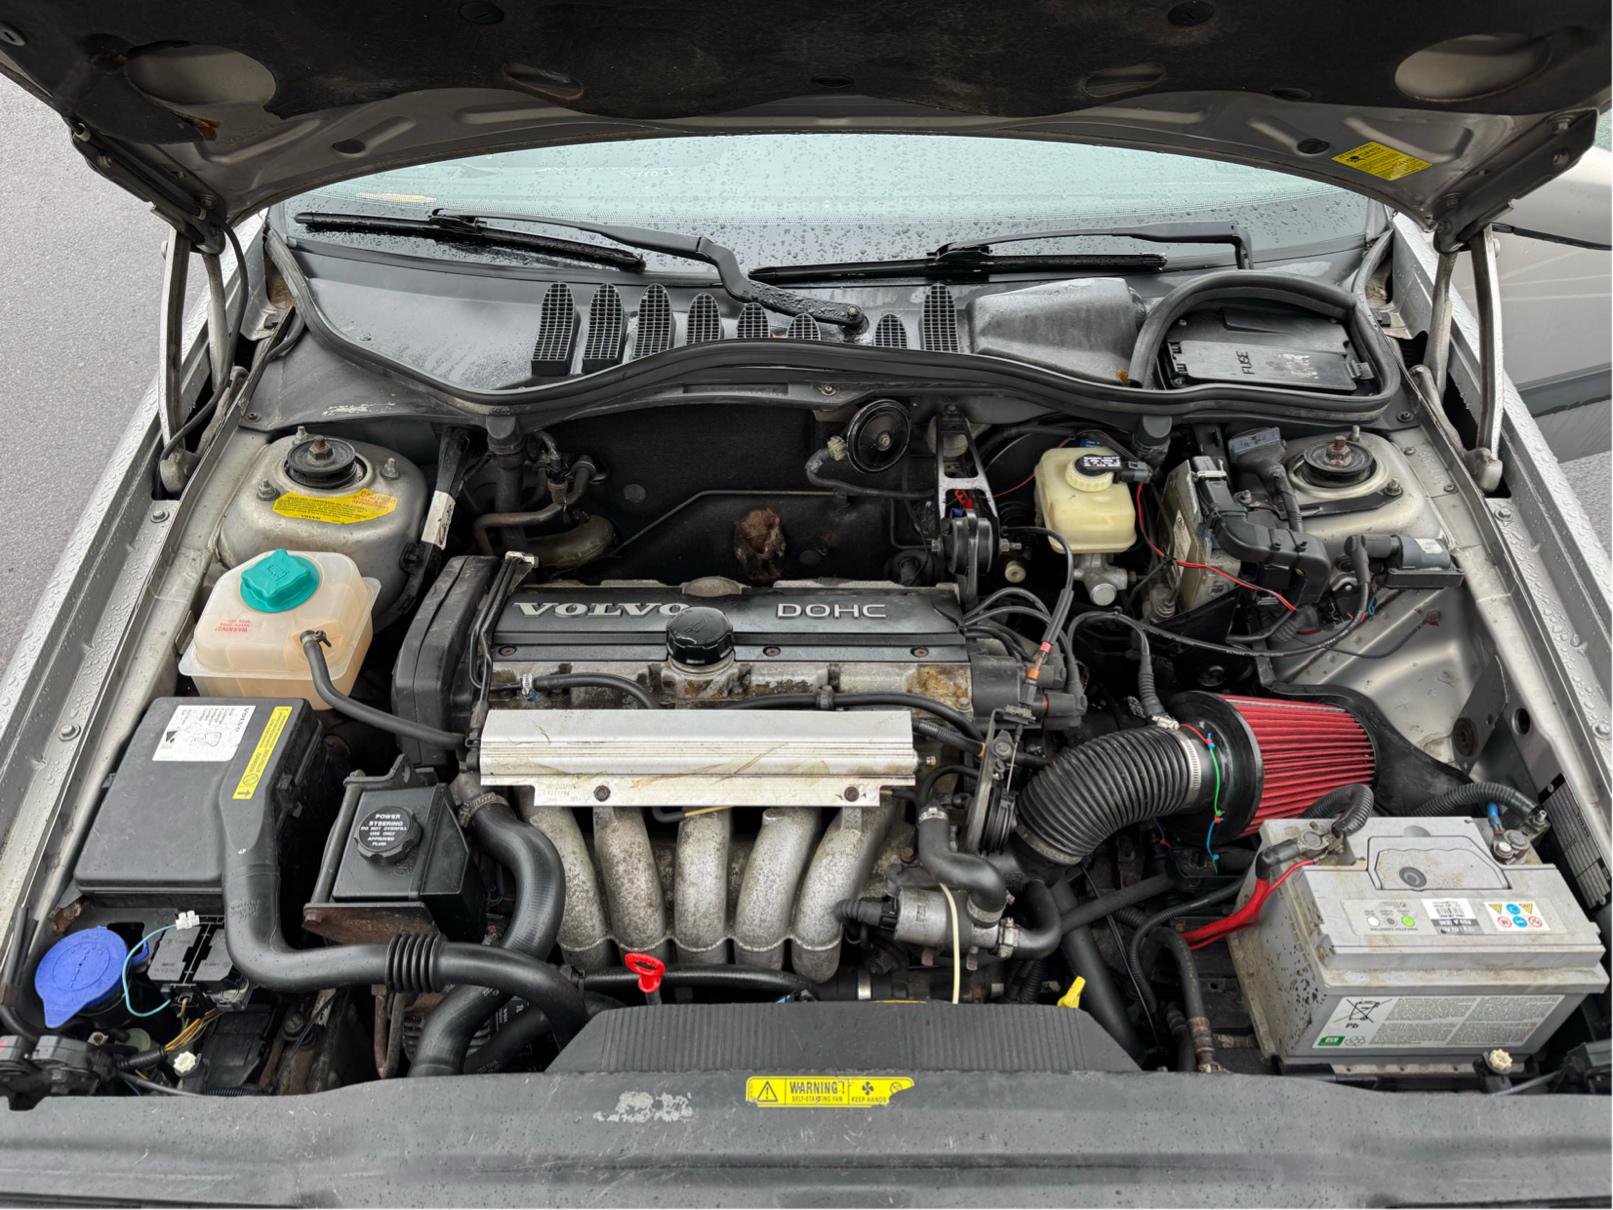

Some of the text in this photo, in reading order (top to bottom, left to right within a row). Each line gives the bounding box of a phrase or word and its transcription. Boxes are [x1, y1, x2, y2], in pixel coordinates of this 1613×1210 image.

[1236, 351, 1255, 375] FUSE
[514, 602, 887, 618] VOLVO DOHC
